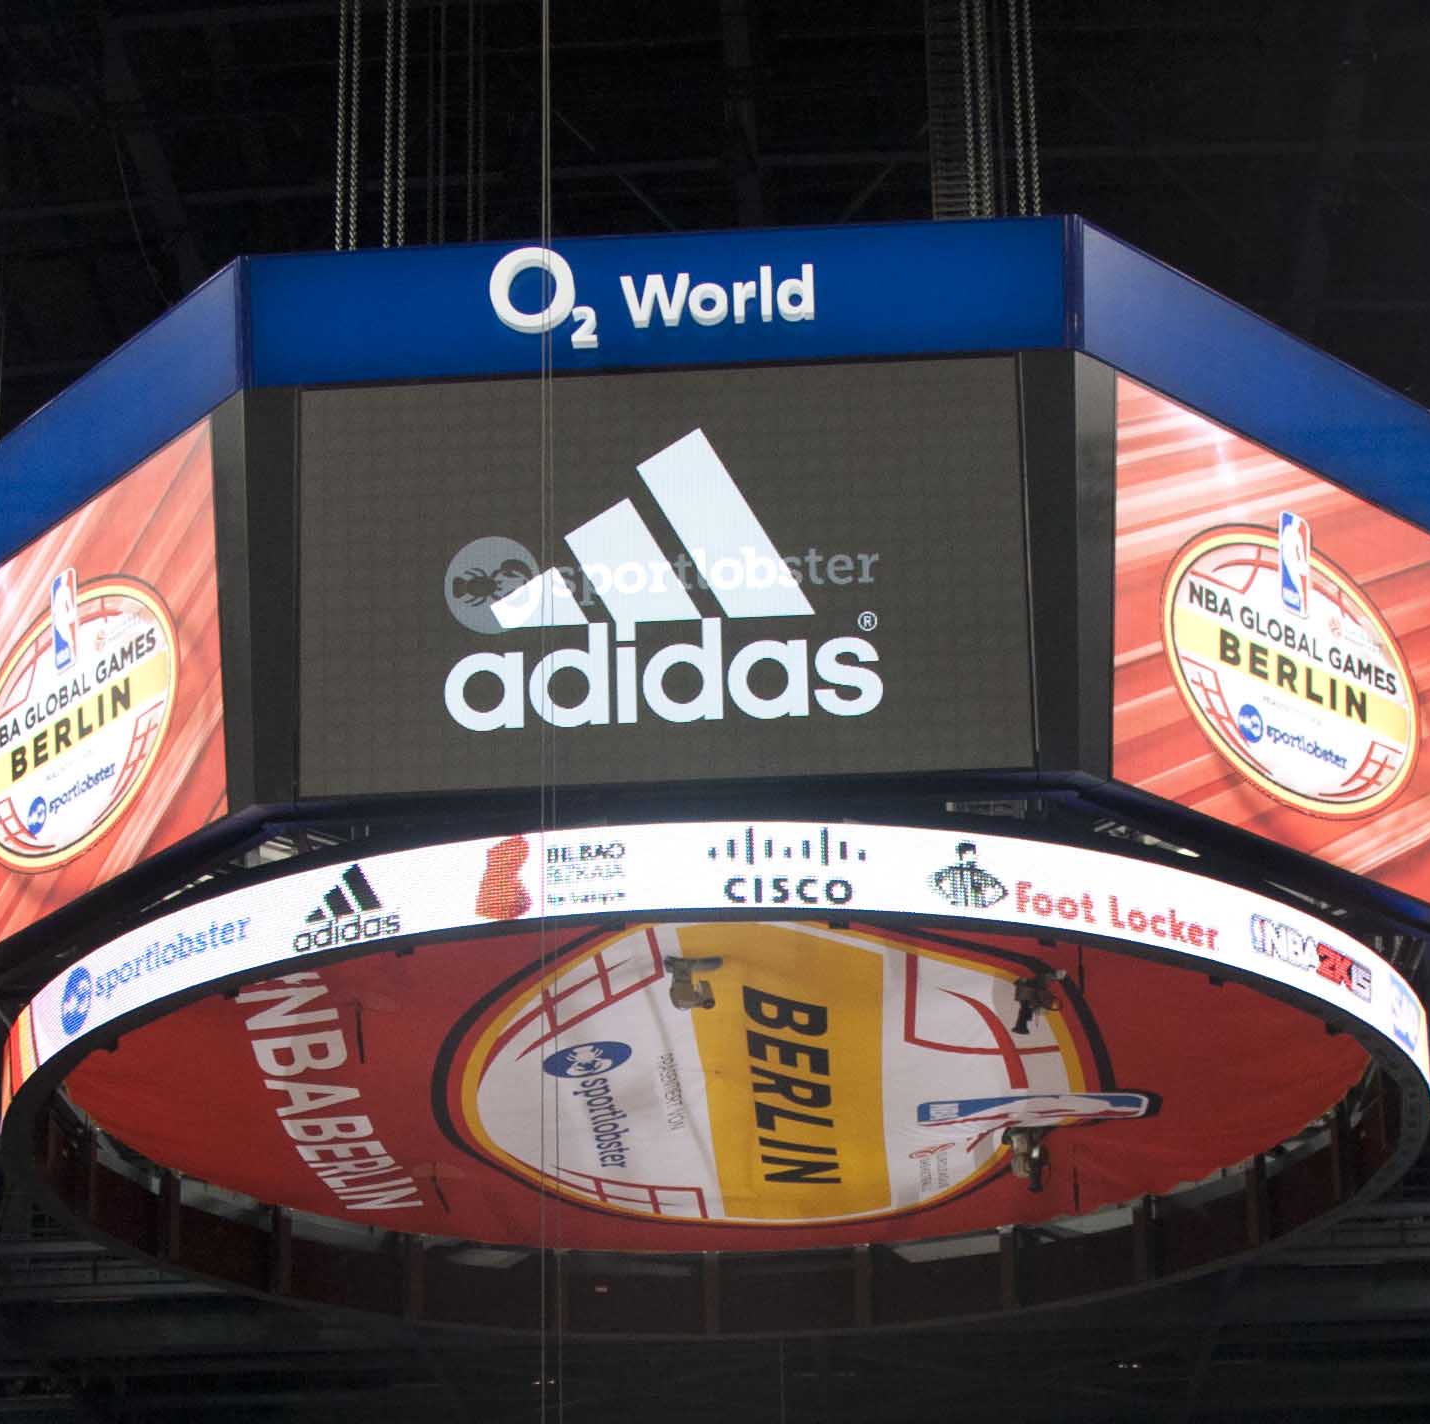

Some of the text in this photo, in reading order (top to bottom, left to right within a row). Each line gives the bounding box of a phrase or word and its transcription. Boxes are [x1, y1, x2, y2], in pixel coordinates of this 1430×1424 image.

[619, 264, 815, 328] World
[25, 671, 91, 729] GLOBAL
[95, 628, 156, 683] GAMES
[444, 617, 883, 732] adidas
[1189, 581, 1233, 622] NBA
[1240, 601, 1323, 663] GLOBAL
[1329, 647, 1397, 696] GAMES
[1219, 628, 1367, 724] BERLIN
[11, 677, 131, 782] BERLIN
[293, 912, 400, 953] adidas
[724, 876, 854, 904] CISCO
[1015, 881, 1219, 951] Foot Locker
[95, 916, 252, 999] sportlobster
[573, 1077, 631, 1169] sportlobster
[741, 985, 843, 1186] BERLIN
